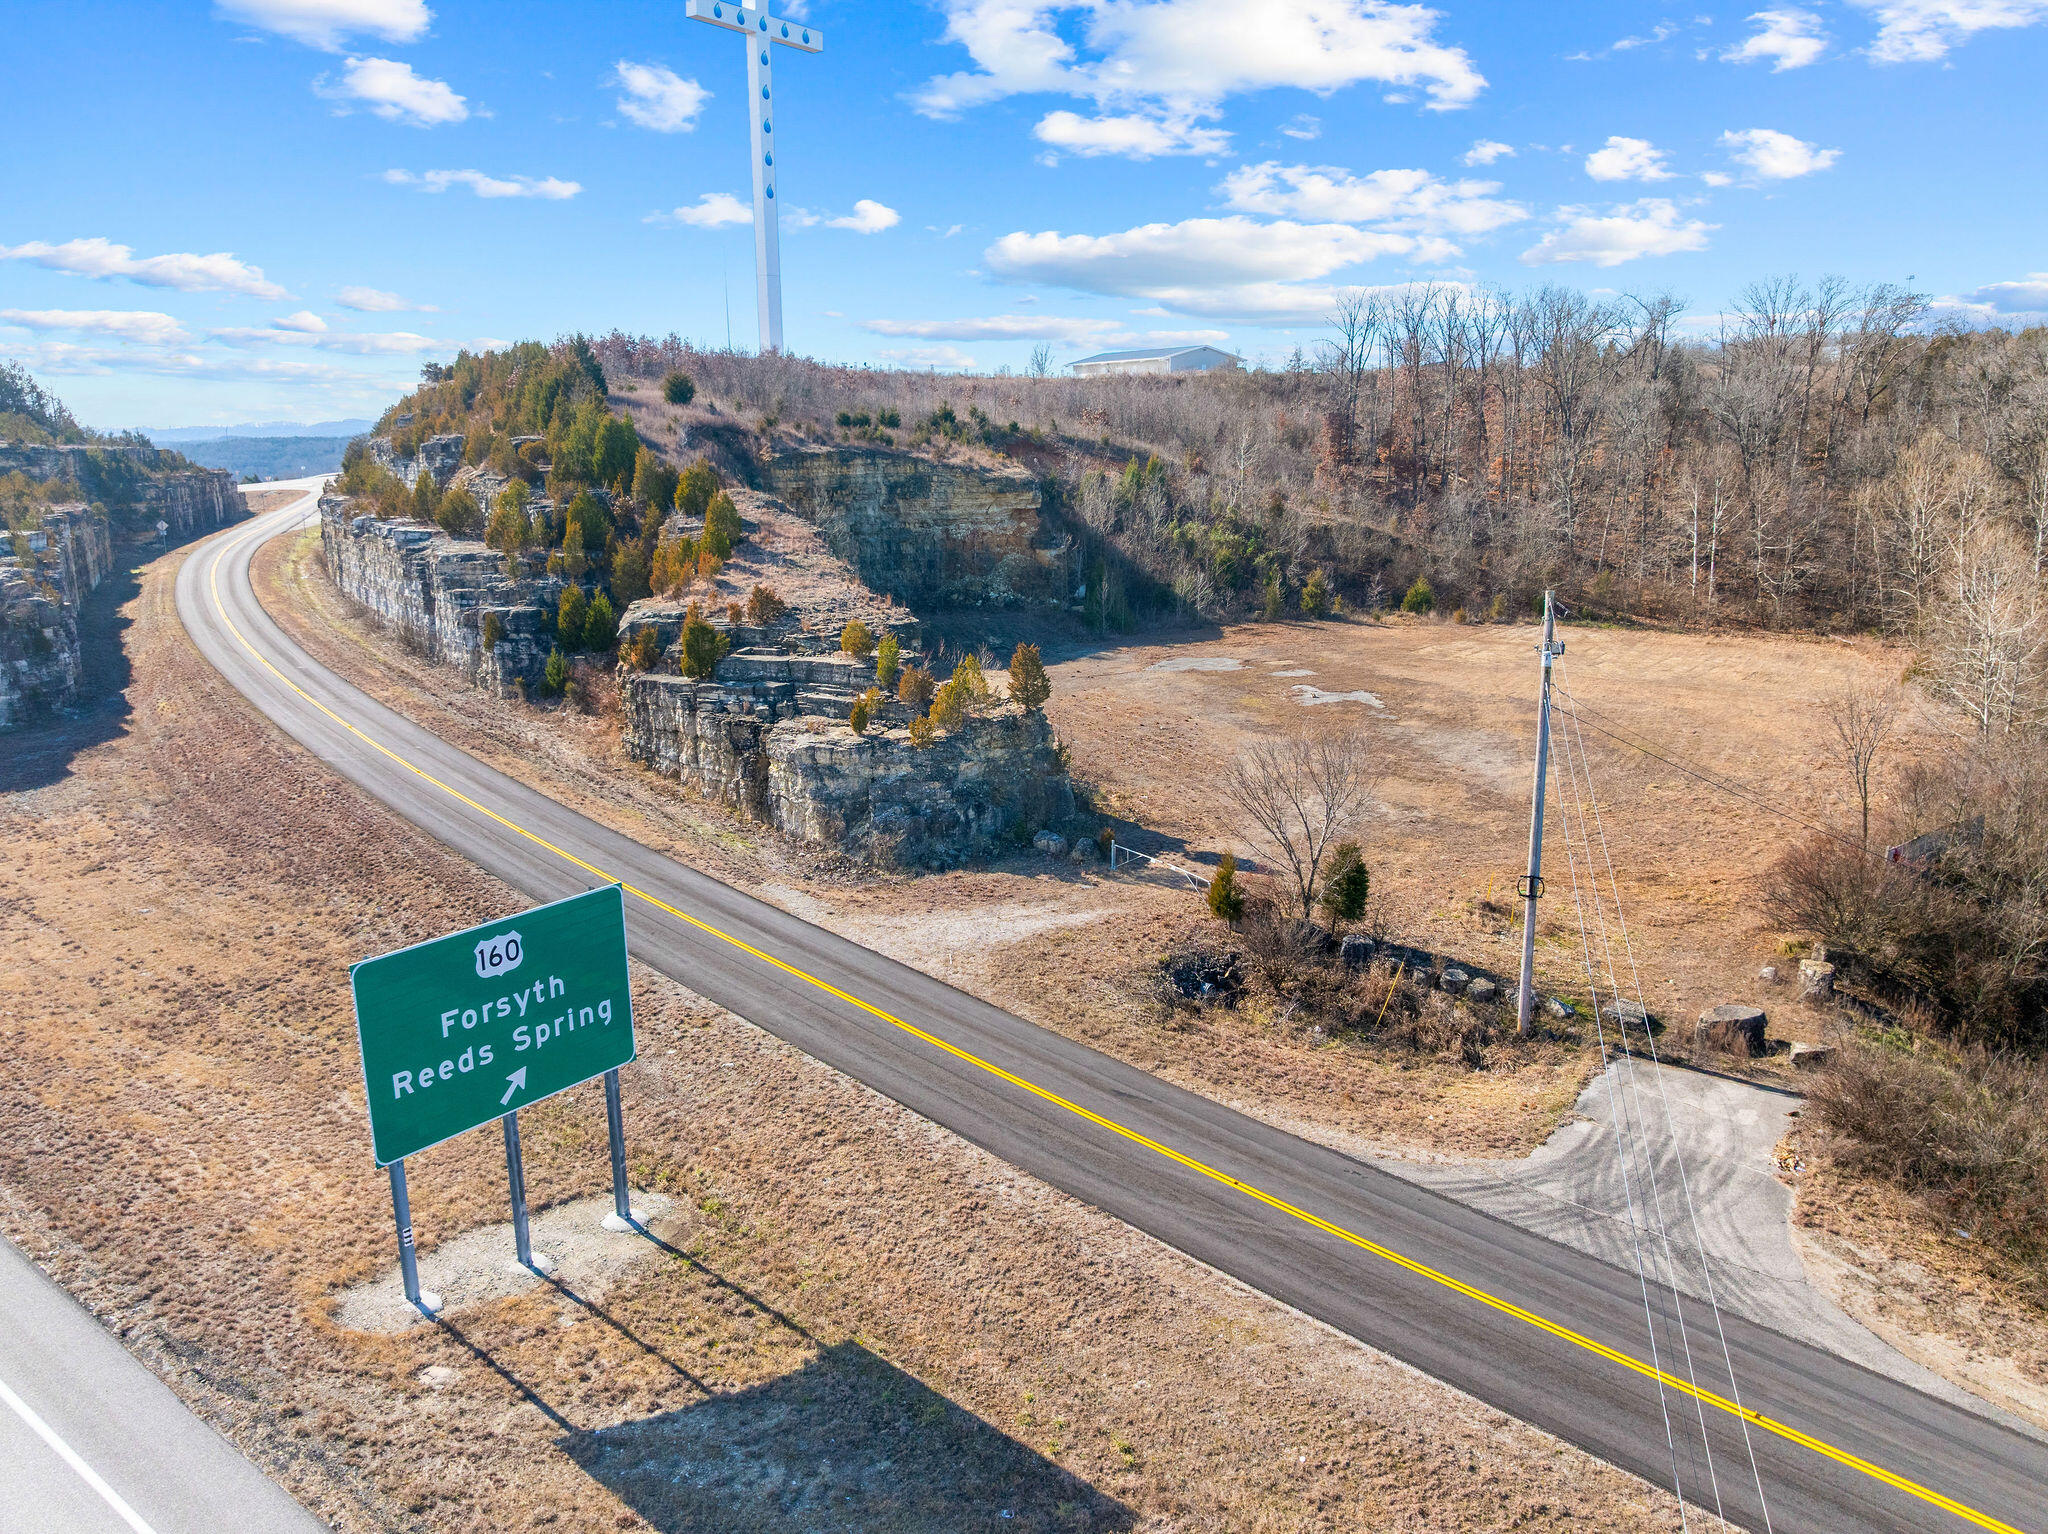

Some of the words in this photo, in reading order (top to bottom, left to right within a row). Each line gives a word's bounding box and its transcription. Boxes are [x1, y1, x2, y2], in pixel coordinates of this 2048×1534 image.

[478, 939, 520, 971] 160
[440, 974, 565, 1038] Forsyth
[392, 1044, 494, 1099] Reeds
[512, 998, 612, 1051] Spring
